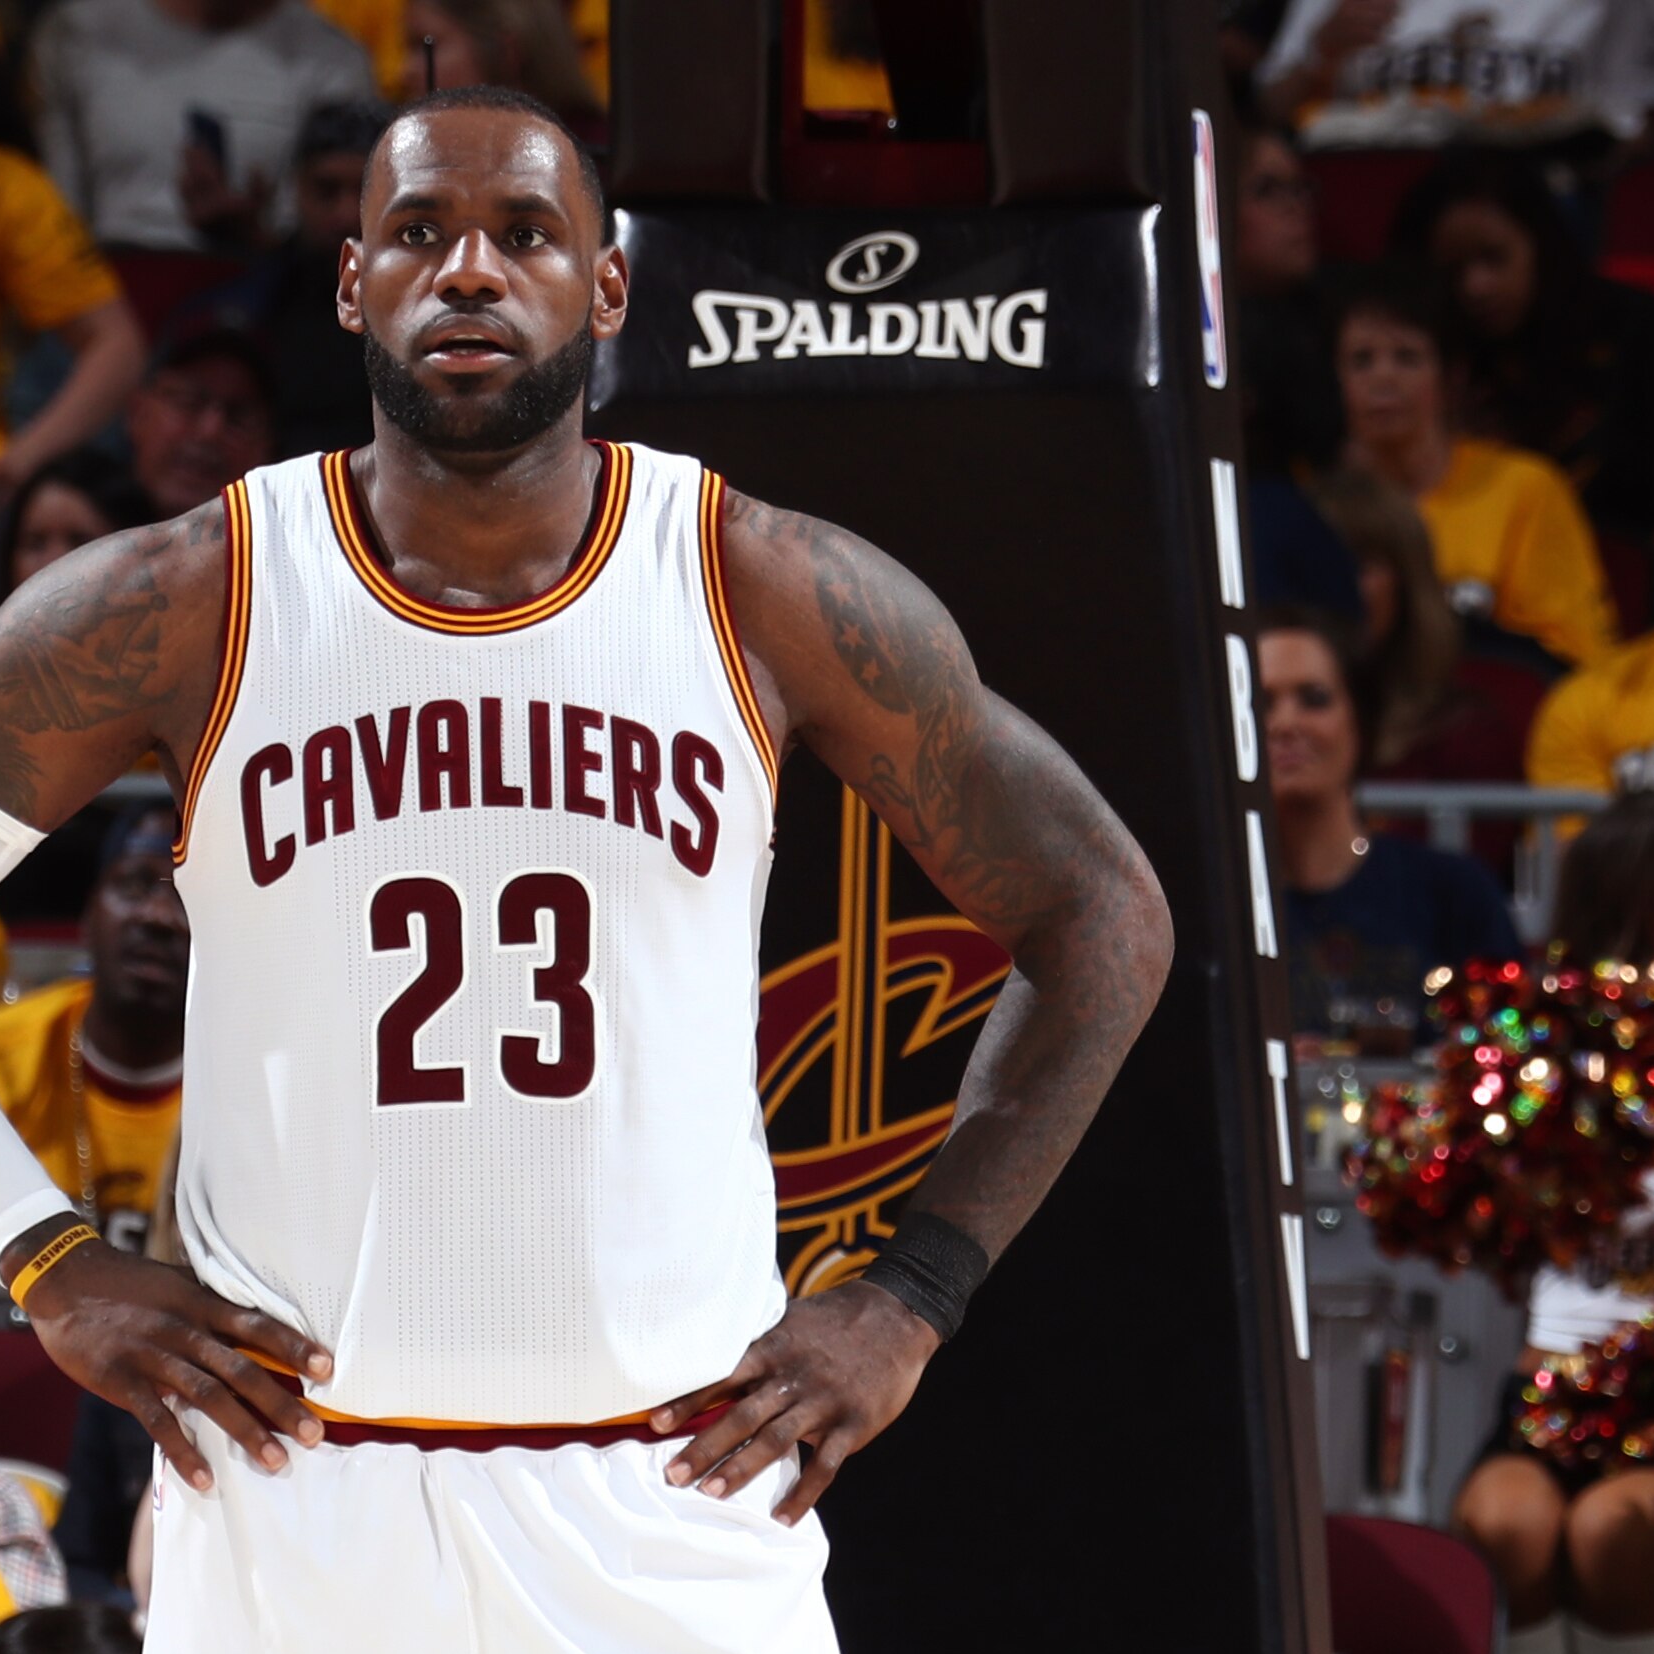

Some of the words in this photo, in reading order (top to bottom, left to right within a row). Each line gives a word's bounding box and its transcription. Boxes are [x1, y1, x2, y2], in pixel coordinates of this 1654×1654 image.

[688, 288, 1048, 369] SPALDING
[240, 697, 724, 888] CAVALIERS
[367, 868, 602, 1110] 23
[31, 1226, 89, 1272] PROMISE
